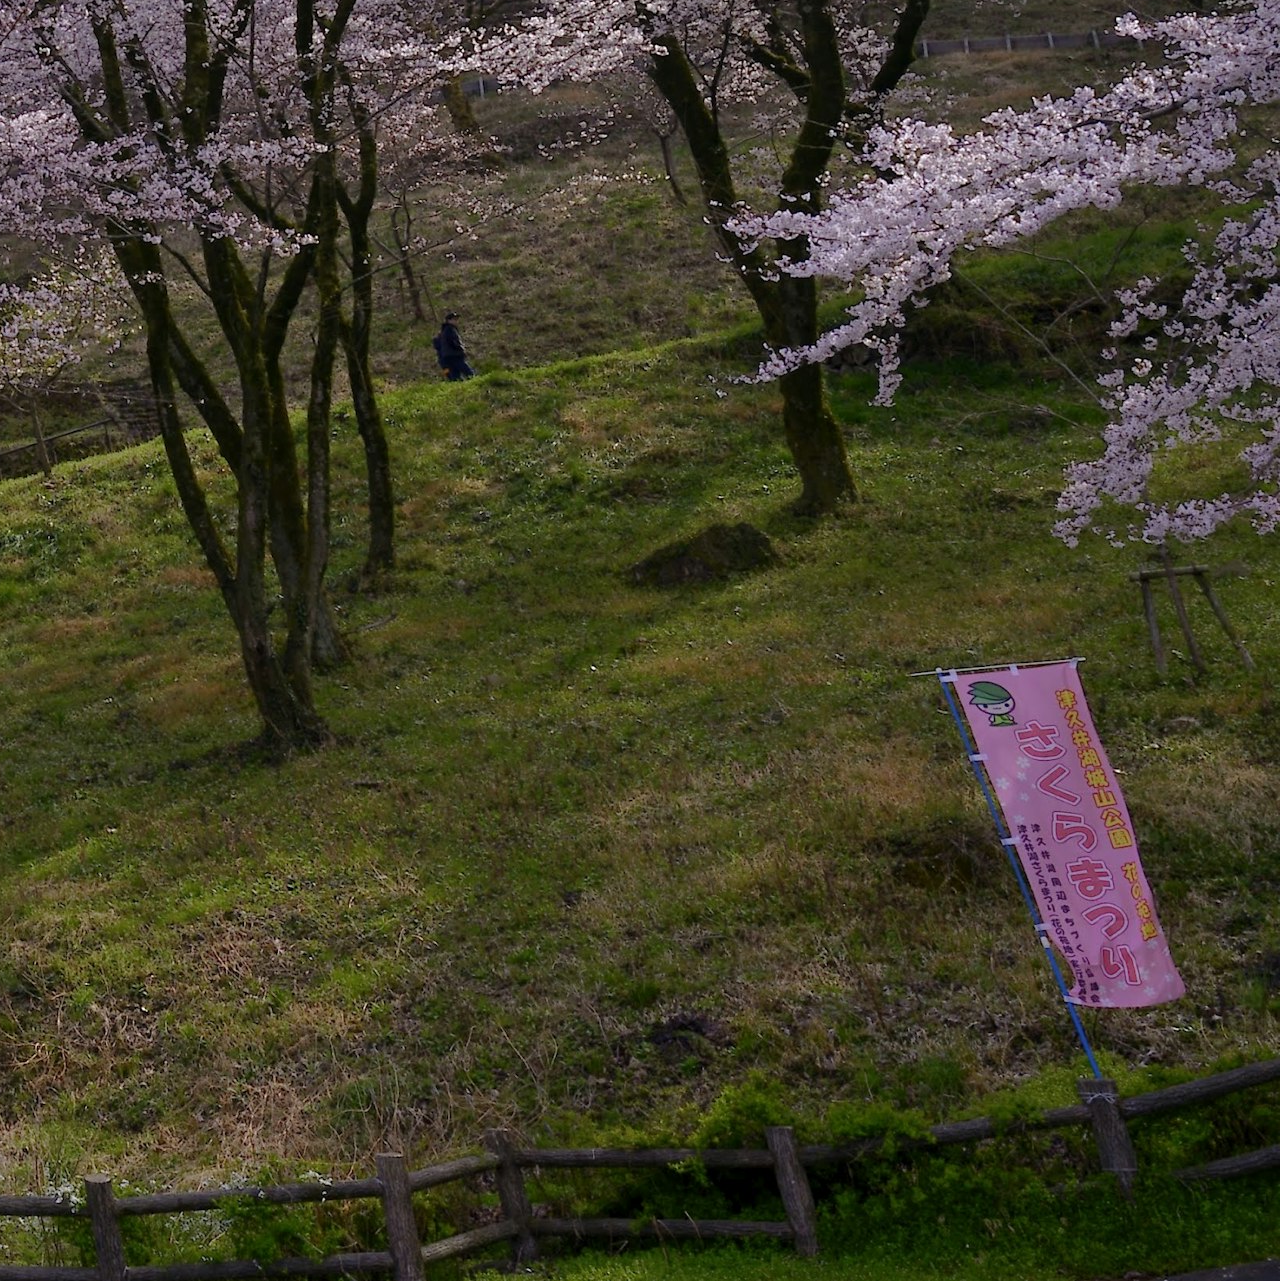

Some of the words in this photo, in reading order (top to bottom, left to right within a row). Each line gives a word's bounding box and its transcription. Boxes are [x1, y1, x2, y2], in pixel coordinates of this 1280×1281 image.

[1014, 719, 1141, 987] さくらまつり
[1054, 688, 1132, 850] 津久井湖城山公園
[1120, 861, 1157, 941] 花の苑地
